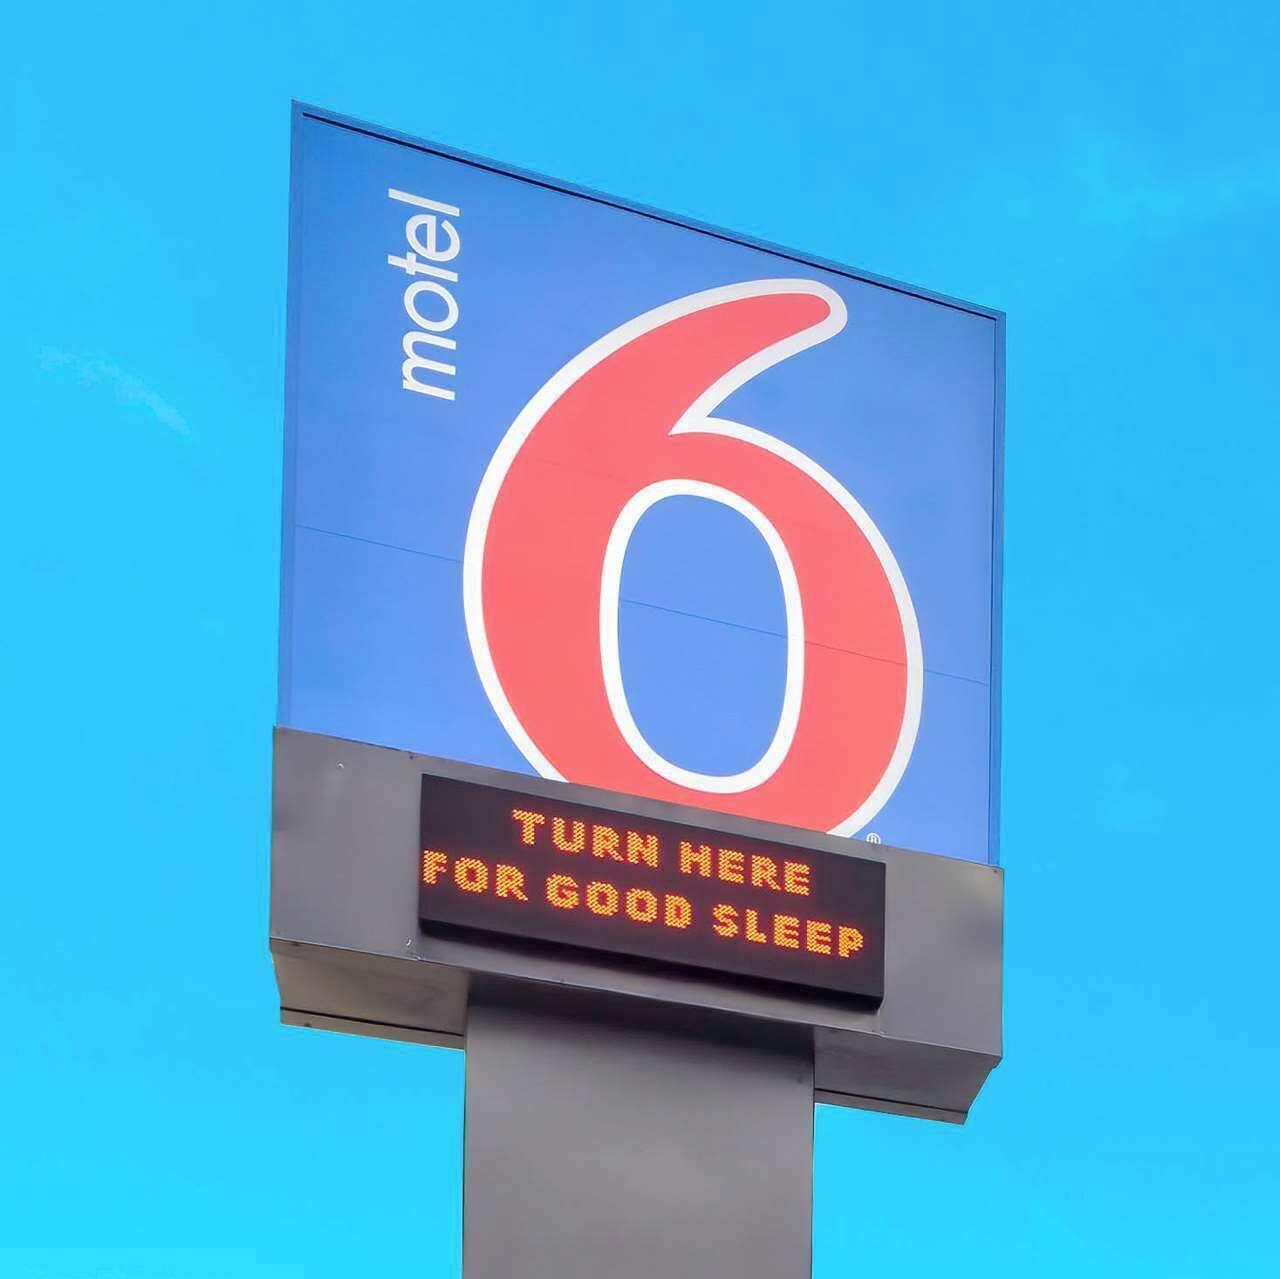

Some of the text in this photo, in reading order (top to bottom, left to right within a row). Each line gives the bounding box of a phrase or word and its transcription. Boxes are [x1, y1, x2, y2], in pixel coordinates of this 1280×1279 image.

[387, 187, 461, 402] motel
[462, 277, 924, 840] 6
[422, 848, 865, 959] FOR GOOD SLEEP
[511, 808, 812, 898] TURN HERE
